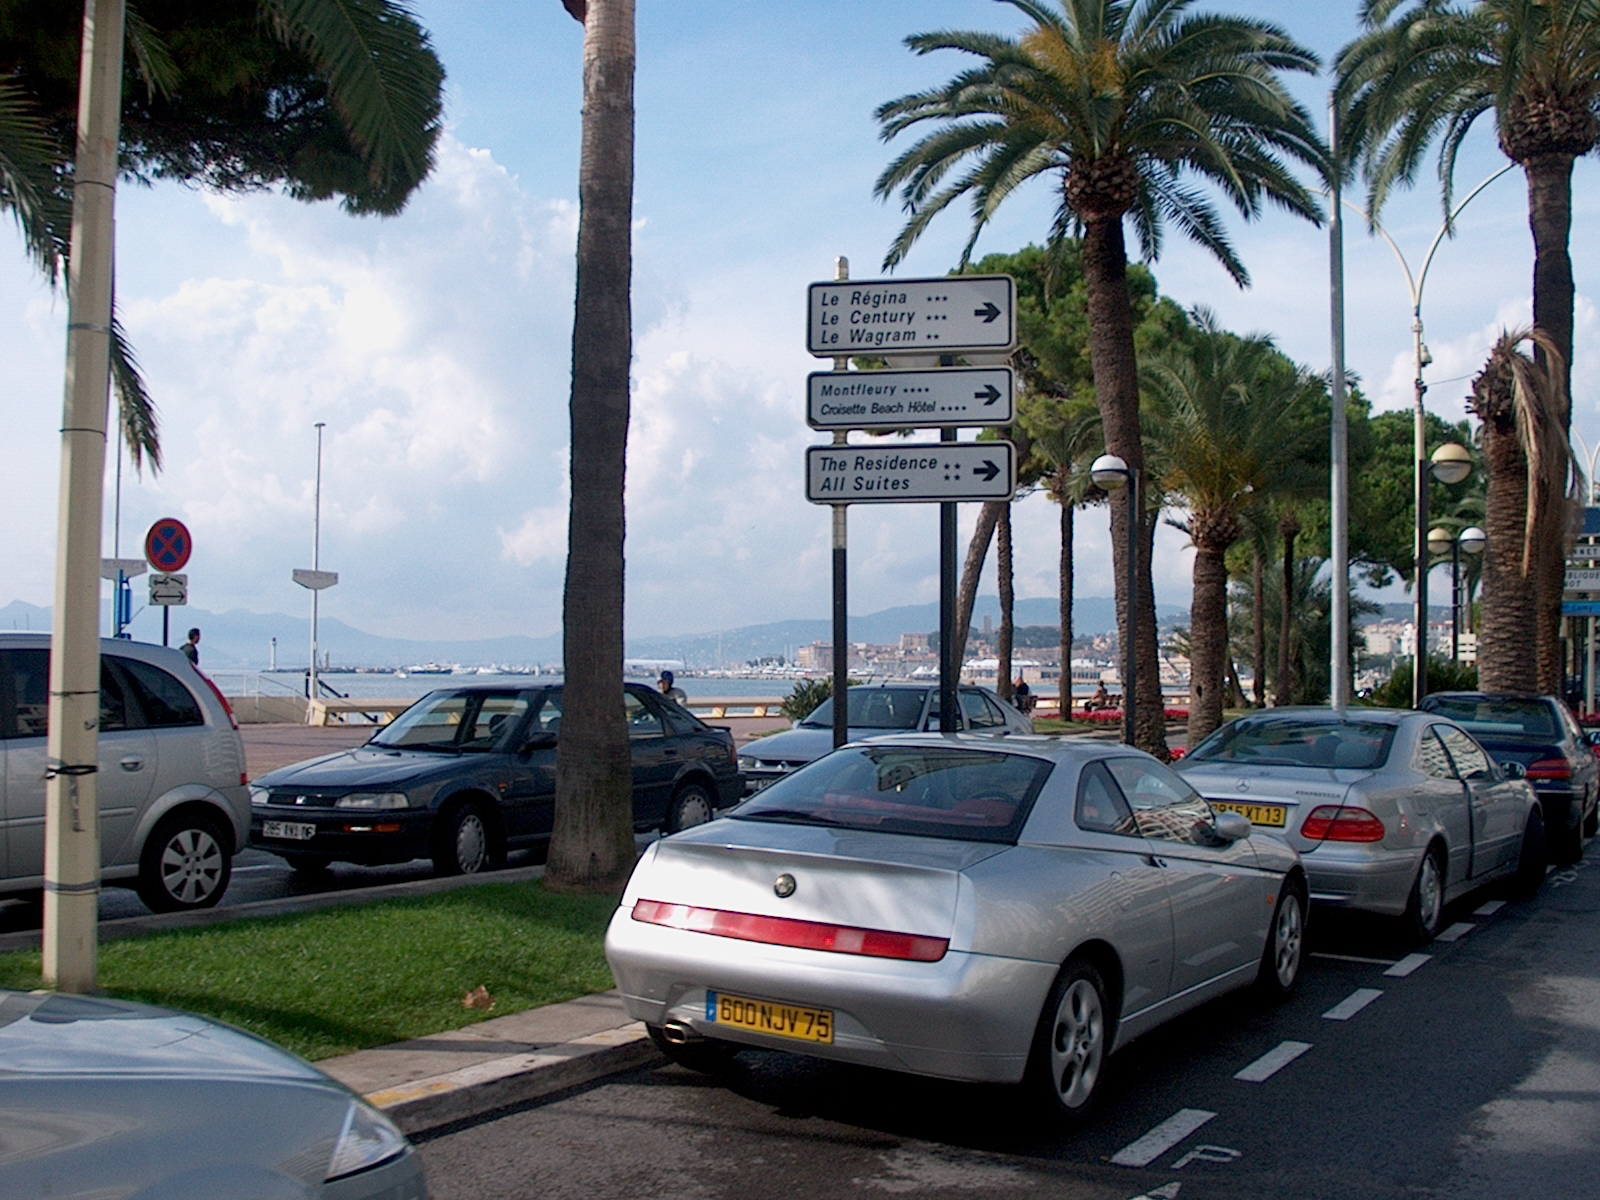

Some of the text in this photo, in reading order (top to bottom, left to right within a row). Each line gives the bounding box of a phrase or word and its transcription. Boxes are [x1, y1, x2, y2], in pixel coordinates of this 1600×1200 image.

[821, 290, 907, 308] Le Régina
[821, 310, 915, 326] Le Century
[821, 328, 917, 346] Le Wagram
[820, 384, 897, 397] Montfleury
[820, 401, 936, 416] Croisette Beach Hôtel
[820, 455, 938, 472] The Residence
[820, 476, 910, 491] All Suites
